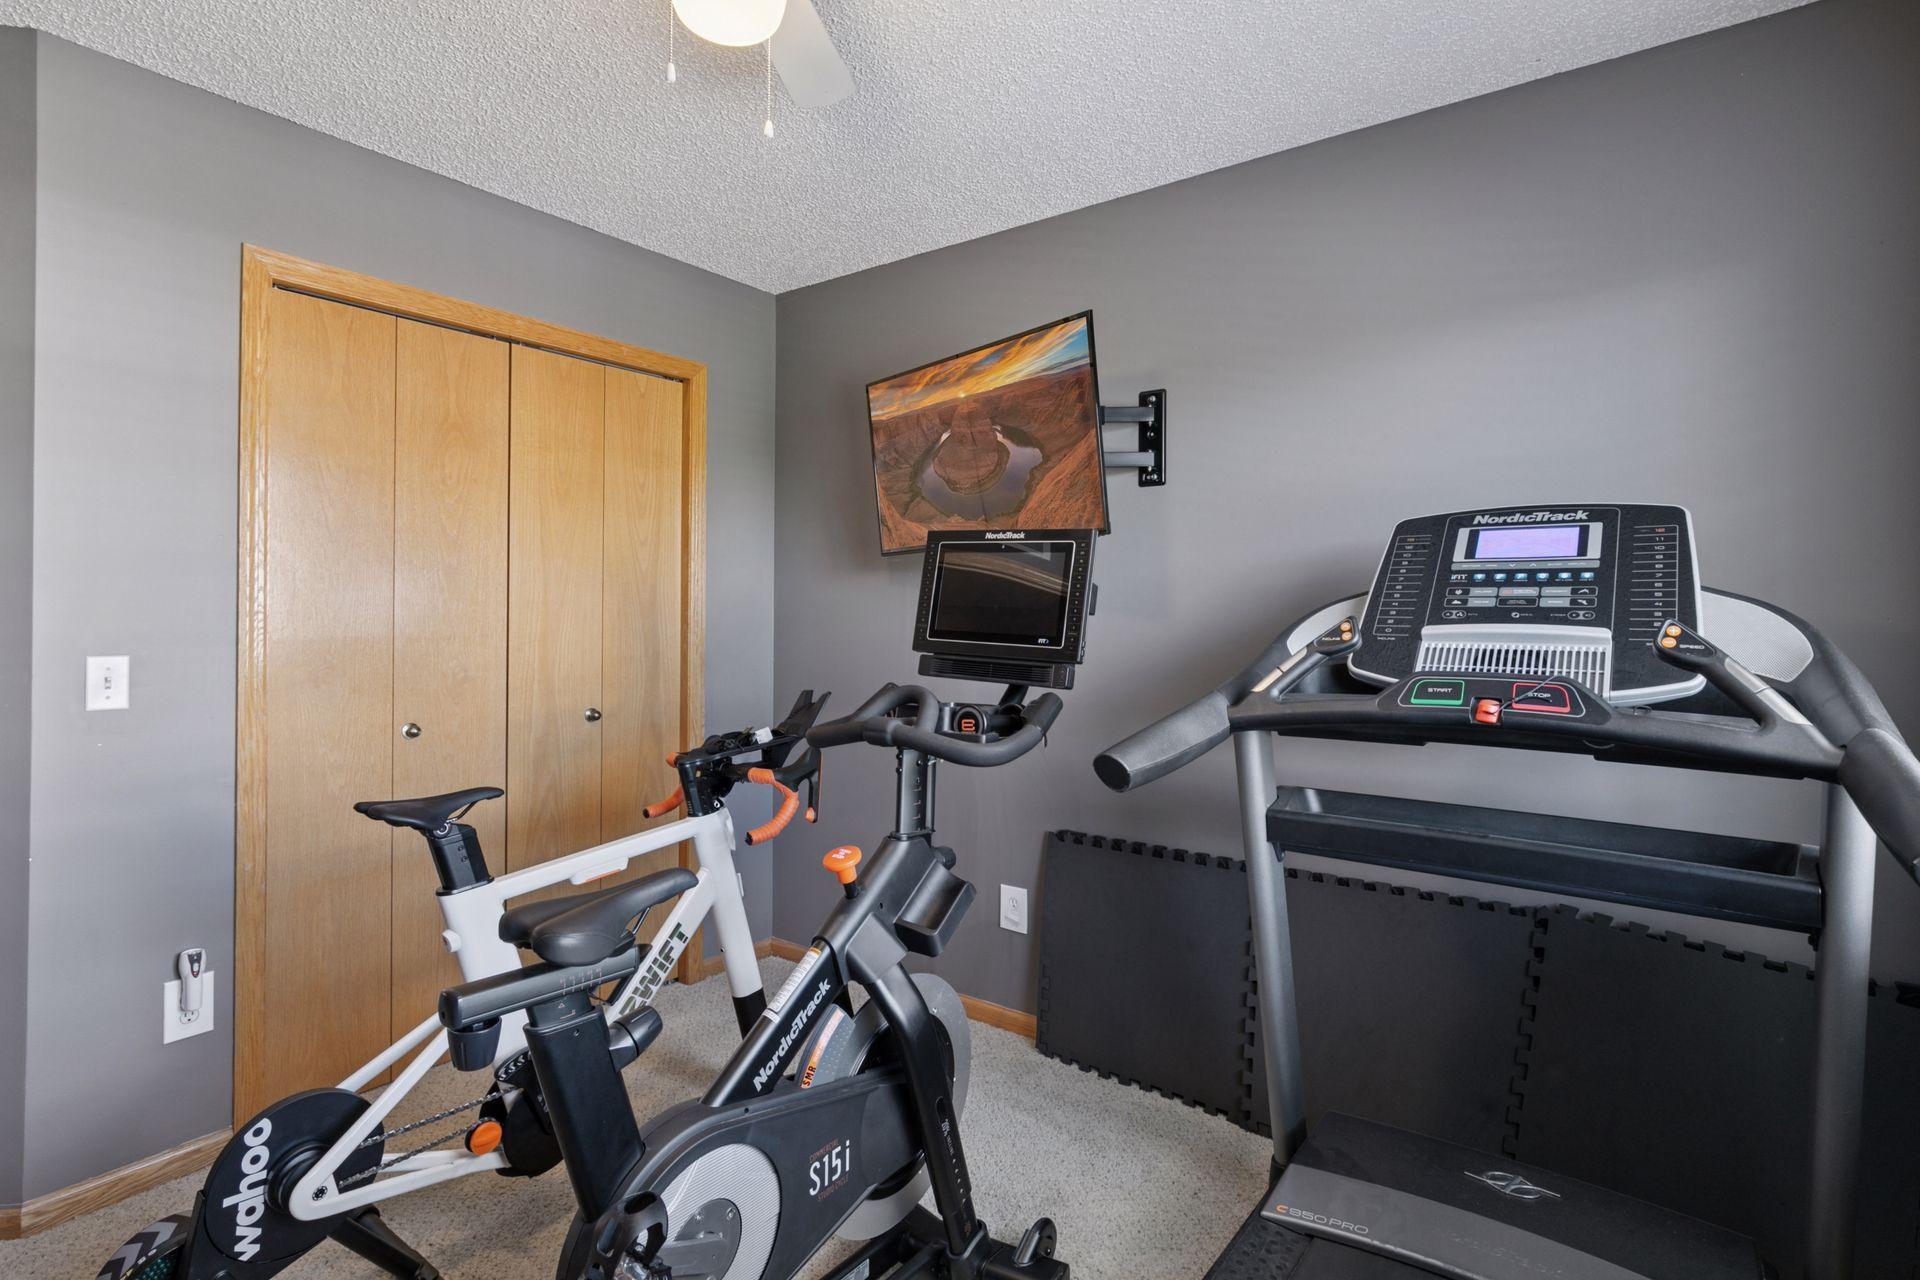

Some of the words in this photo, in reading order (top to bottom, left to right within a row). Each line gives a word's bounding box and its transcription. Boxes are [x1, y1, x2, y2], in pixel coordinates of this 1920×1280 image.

[1473, 510, 1590, 525] NordicTrack
[985, 531, 1025, 539] NordicTrack
[753, 978, 831, 1092] NordicTrack
[802, 1065, 817, 1087] SMR
[809, 1139, 850, 1196] S15i
[222, 1117, 272, 1262] wahoo
[1329, 1218, 1369, 1234] PRO
